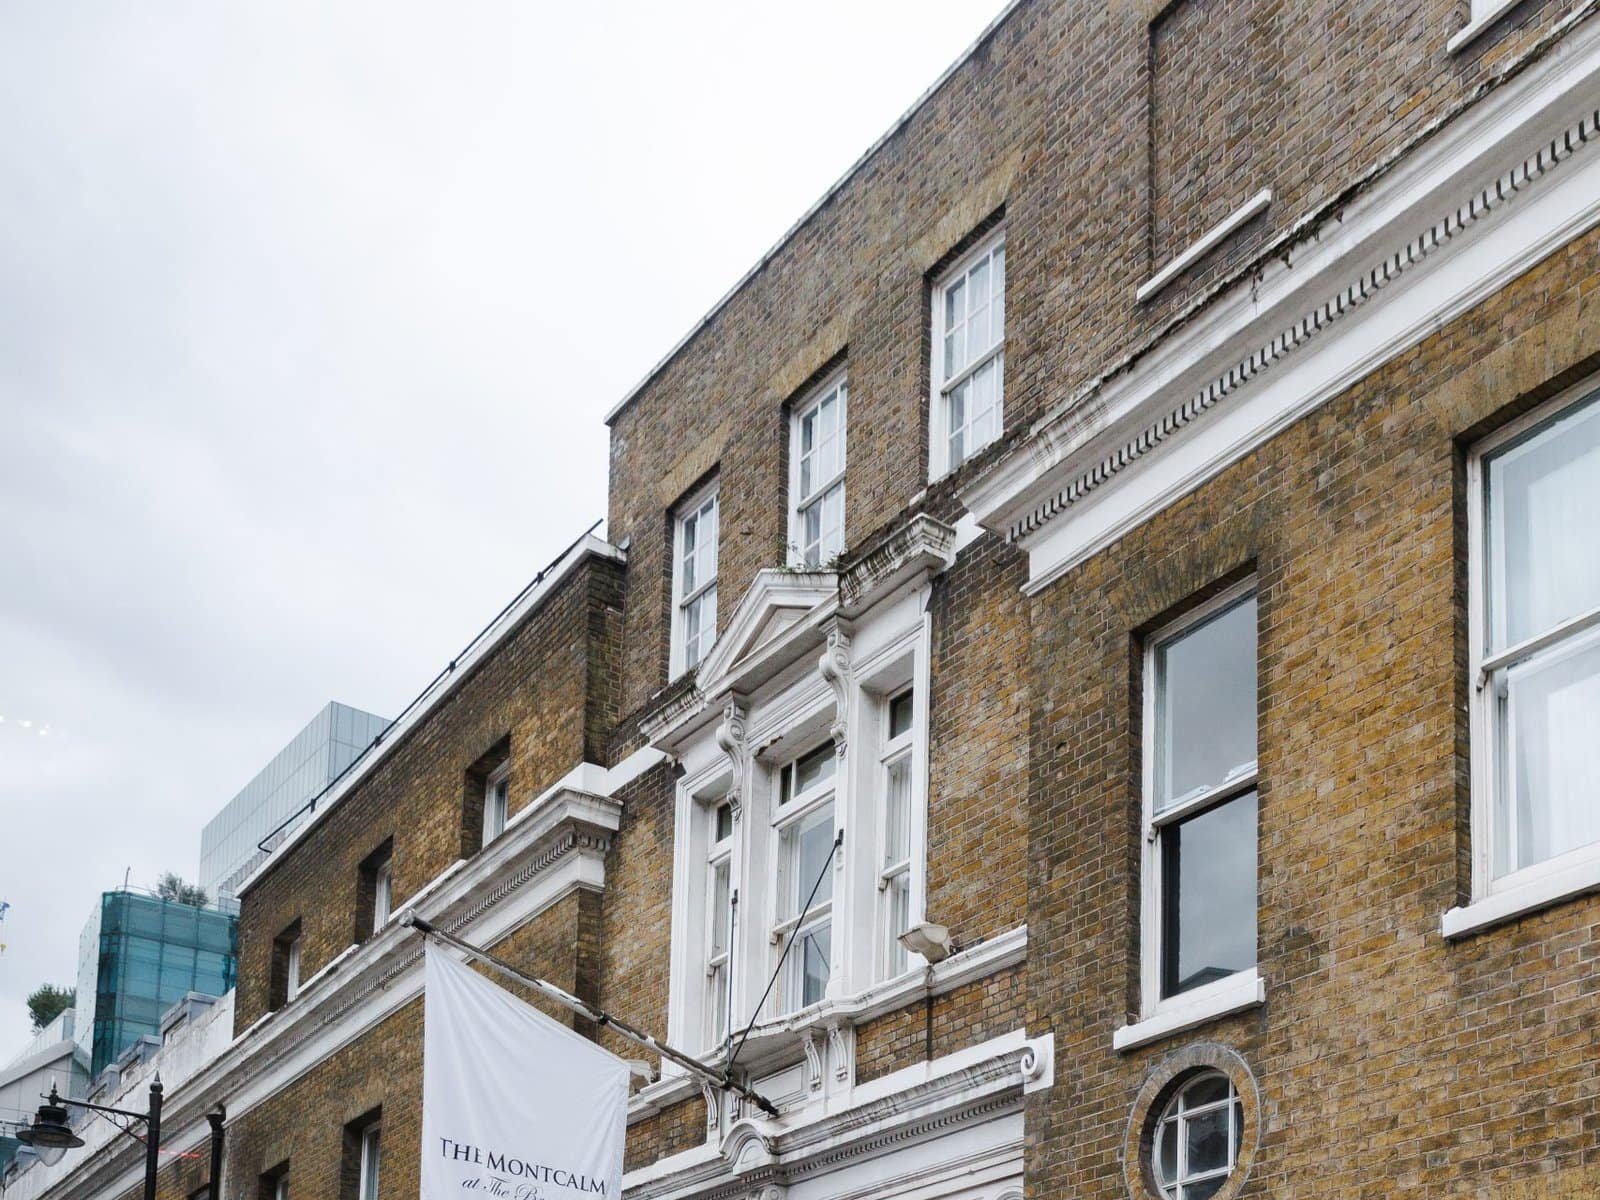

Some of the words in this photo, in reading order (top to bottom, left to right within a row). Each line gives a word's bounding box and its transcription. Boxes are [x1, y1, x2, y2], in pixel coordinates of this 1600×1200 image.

[462, 1177, 480, 1189] at
[483, 1176, 511, 1198] The
[487, 1151, 606, 1195] MONTCALM
